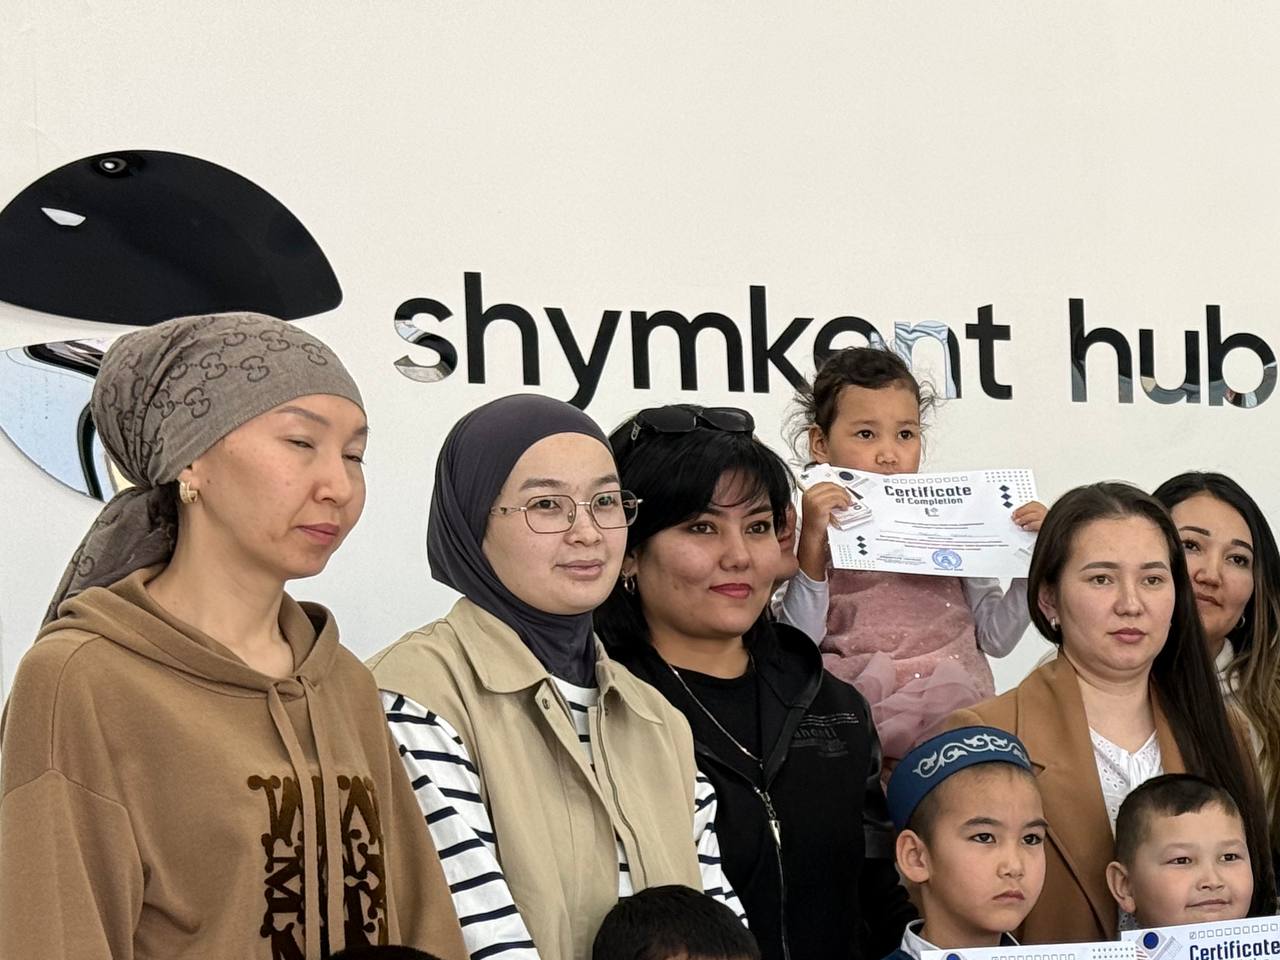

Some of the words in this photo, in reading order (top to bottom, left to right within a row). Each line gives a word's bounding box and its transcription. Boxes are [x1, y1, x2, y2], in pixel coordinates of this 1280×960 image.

[1068, 298, 1278, 409] hub
[884, 484, 972, 498] Certificate
[895, 497, 906, 505] of
[908, 497, 963, 506] Completion
